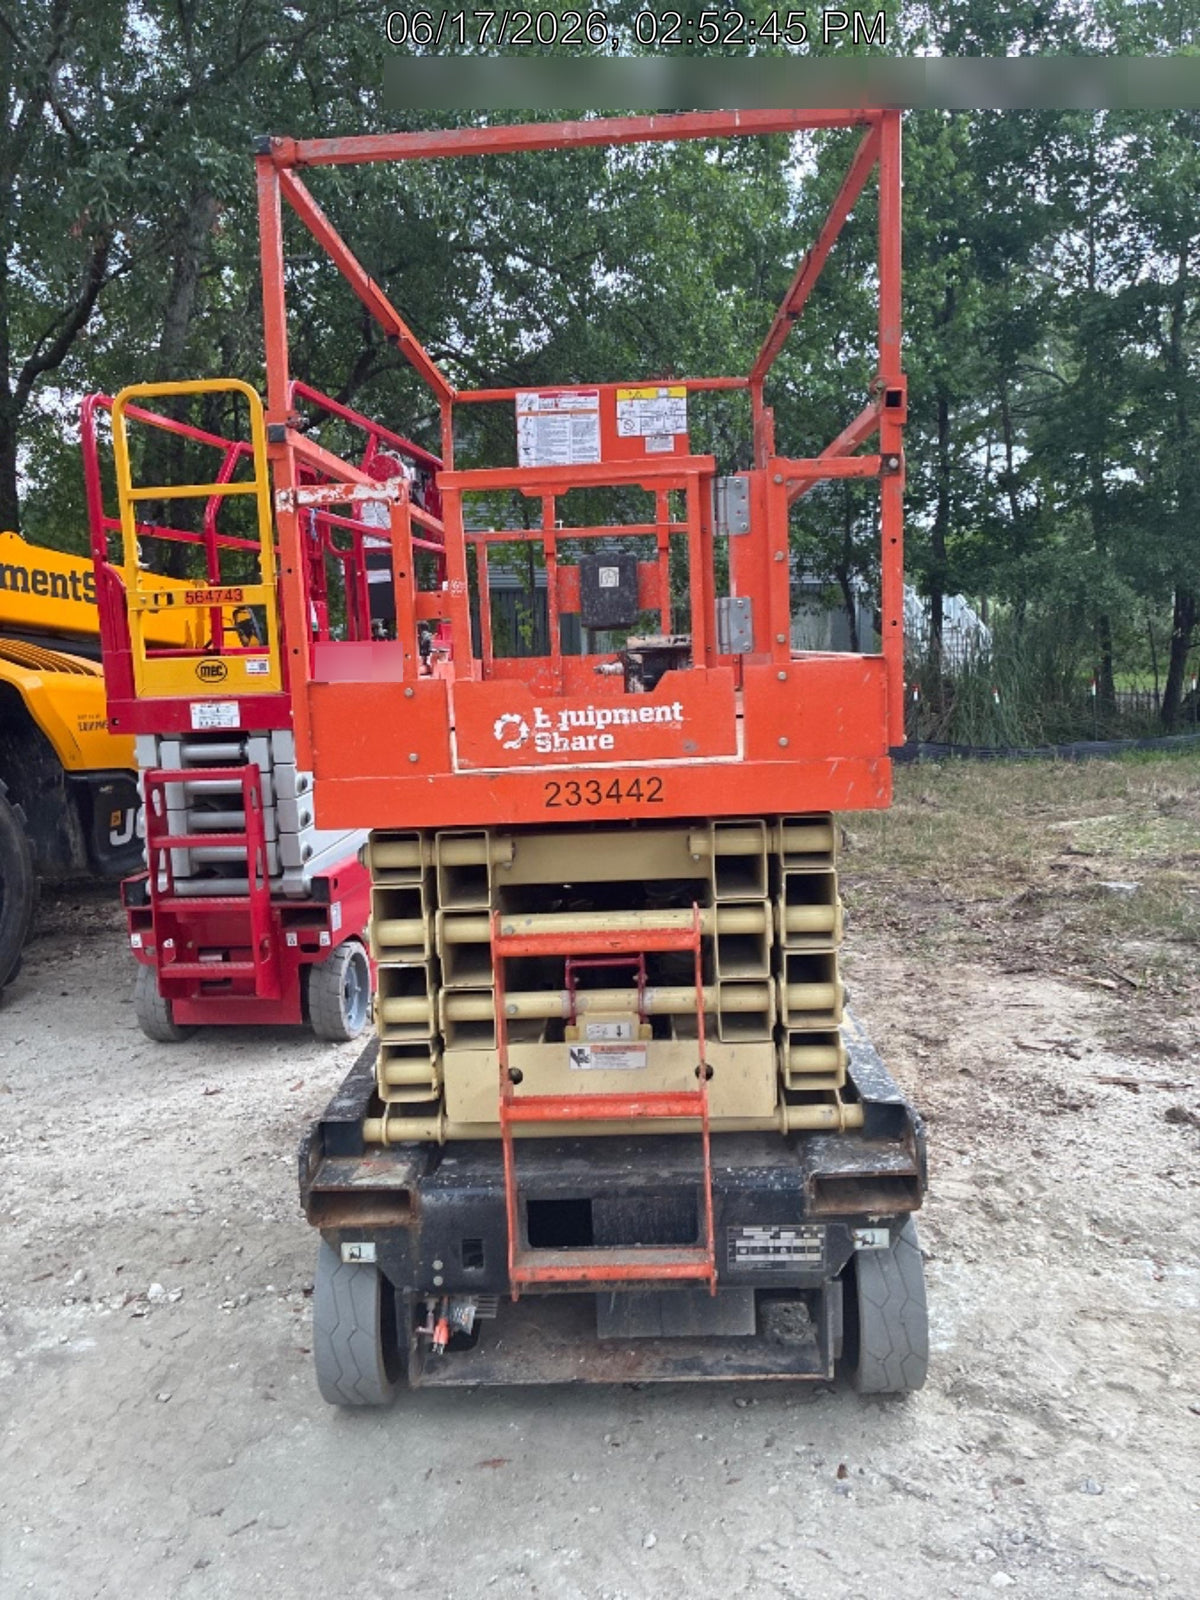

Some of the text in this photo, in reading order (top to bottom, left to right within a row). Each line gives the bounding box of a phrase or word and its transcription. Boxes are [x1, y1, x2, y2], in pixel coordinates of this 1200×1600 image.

[185, 588, 244, 605] 564743
[534, 732, 615, 753] Share
[544, 776, 665, 808] 233442
